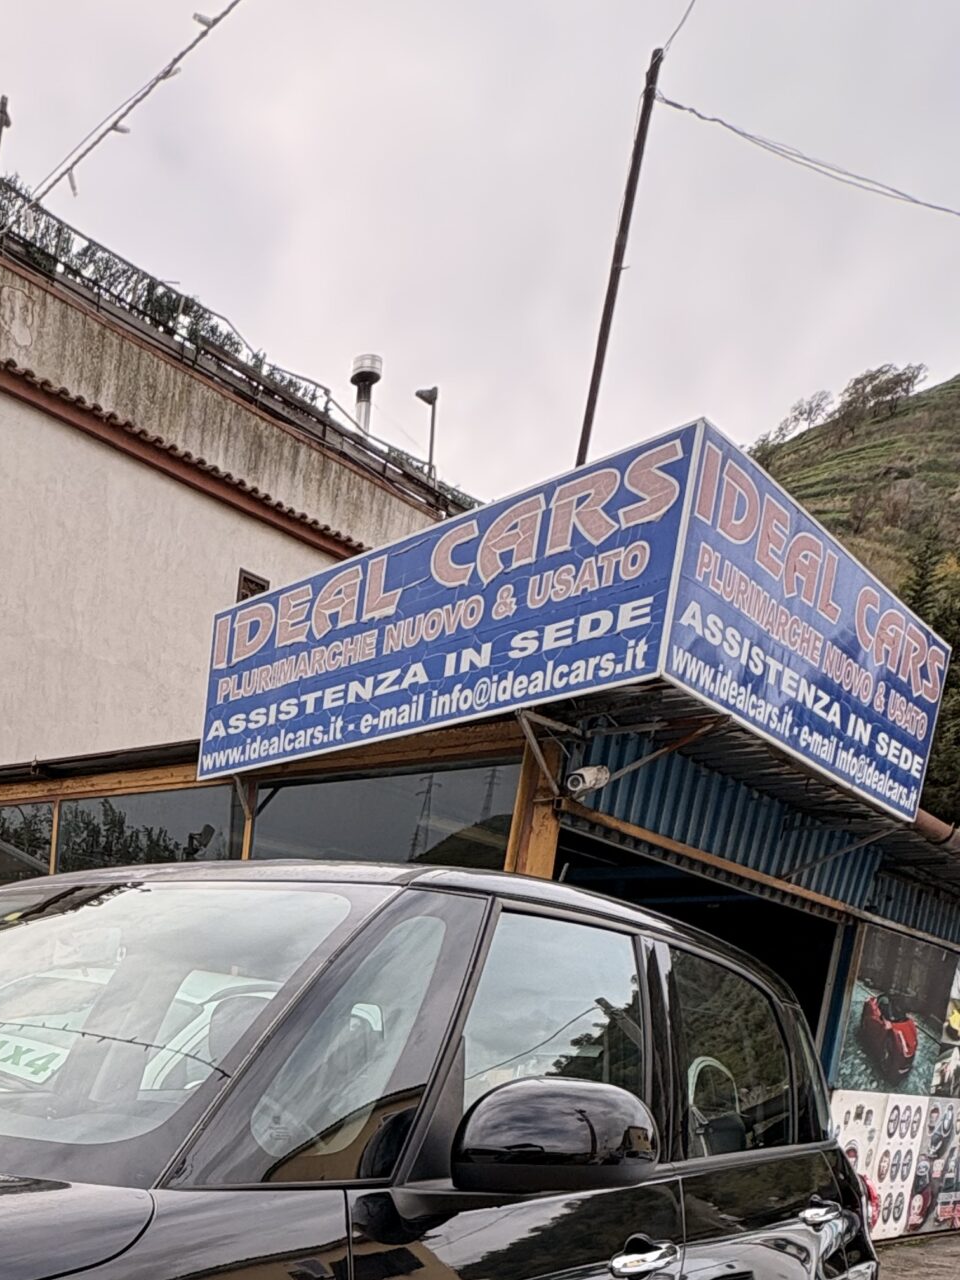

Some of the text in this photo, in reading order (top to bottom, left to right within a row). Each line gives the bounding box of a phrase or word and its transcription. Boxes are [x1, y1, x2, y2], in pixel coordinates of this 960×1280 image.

[212, 438, 685, 669] IDEAL CARS
[216, 540, 651, 705] PLURIMARCHE NUOVO & USATO
[695, 440, 946, 703] IDEAL CARS
[201, 717, 343, 771] www.idealcars.it
[359, 695, 424, 733] e-mail
[430, 639, 647, 719] info@idealcars.it
[205, 597, 655, 742] ASSISTENZA IN SEDE
[671, 644, 792, 739] www.idealcars.it
[799, 725, 836, 768] e-mail
[835, 742, 917, 813] info@idealcars.it
[680, 600, 924, 780] ASSISTENZA IN SEDE
[695, 541, 927, 742] PLURIMARCHE NUOVO & USATO
